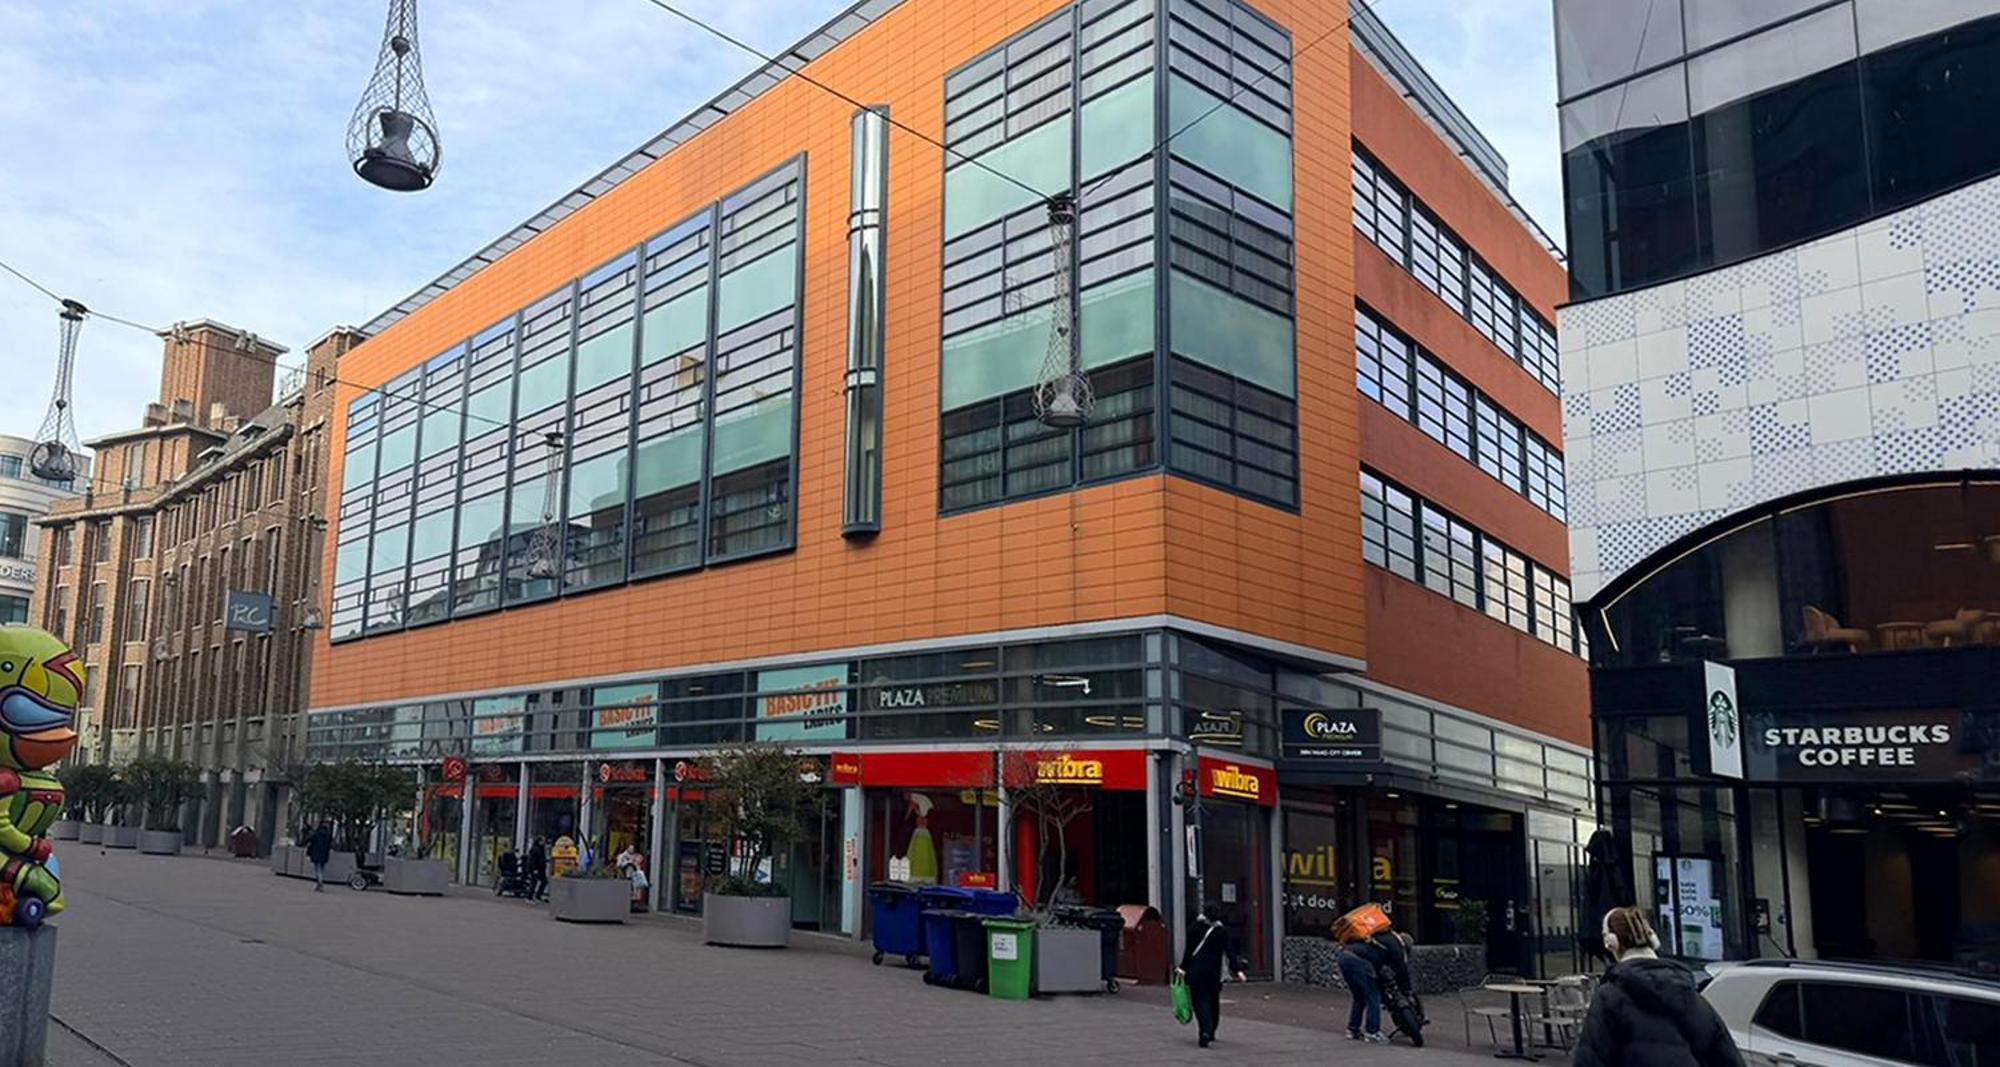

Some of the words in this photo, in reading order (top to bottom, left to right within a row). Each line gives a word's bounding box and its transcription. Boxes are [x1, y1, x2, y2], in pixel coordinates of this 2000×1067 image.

[880, 687, 925, 708] PLAZA
[1316, 721, 1358, 734] PLAZA
[1765, 724, 1951, 747] STARBUCKS
[1037, 752, 1104, 778] wibra
[1799, 747, 1916, 767] COFFEE
[1211, 765, 1260, 793] wibra
